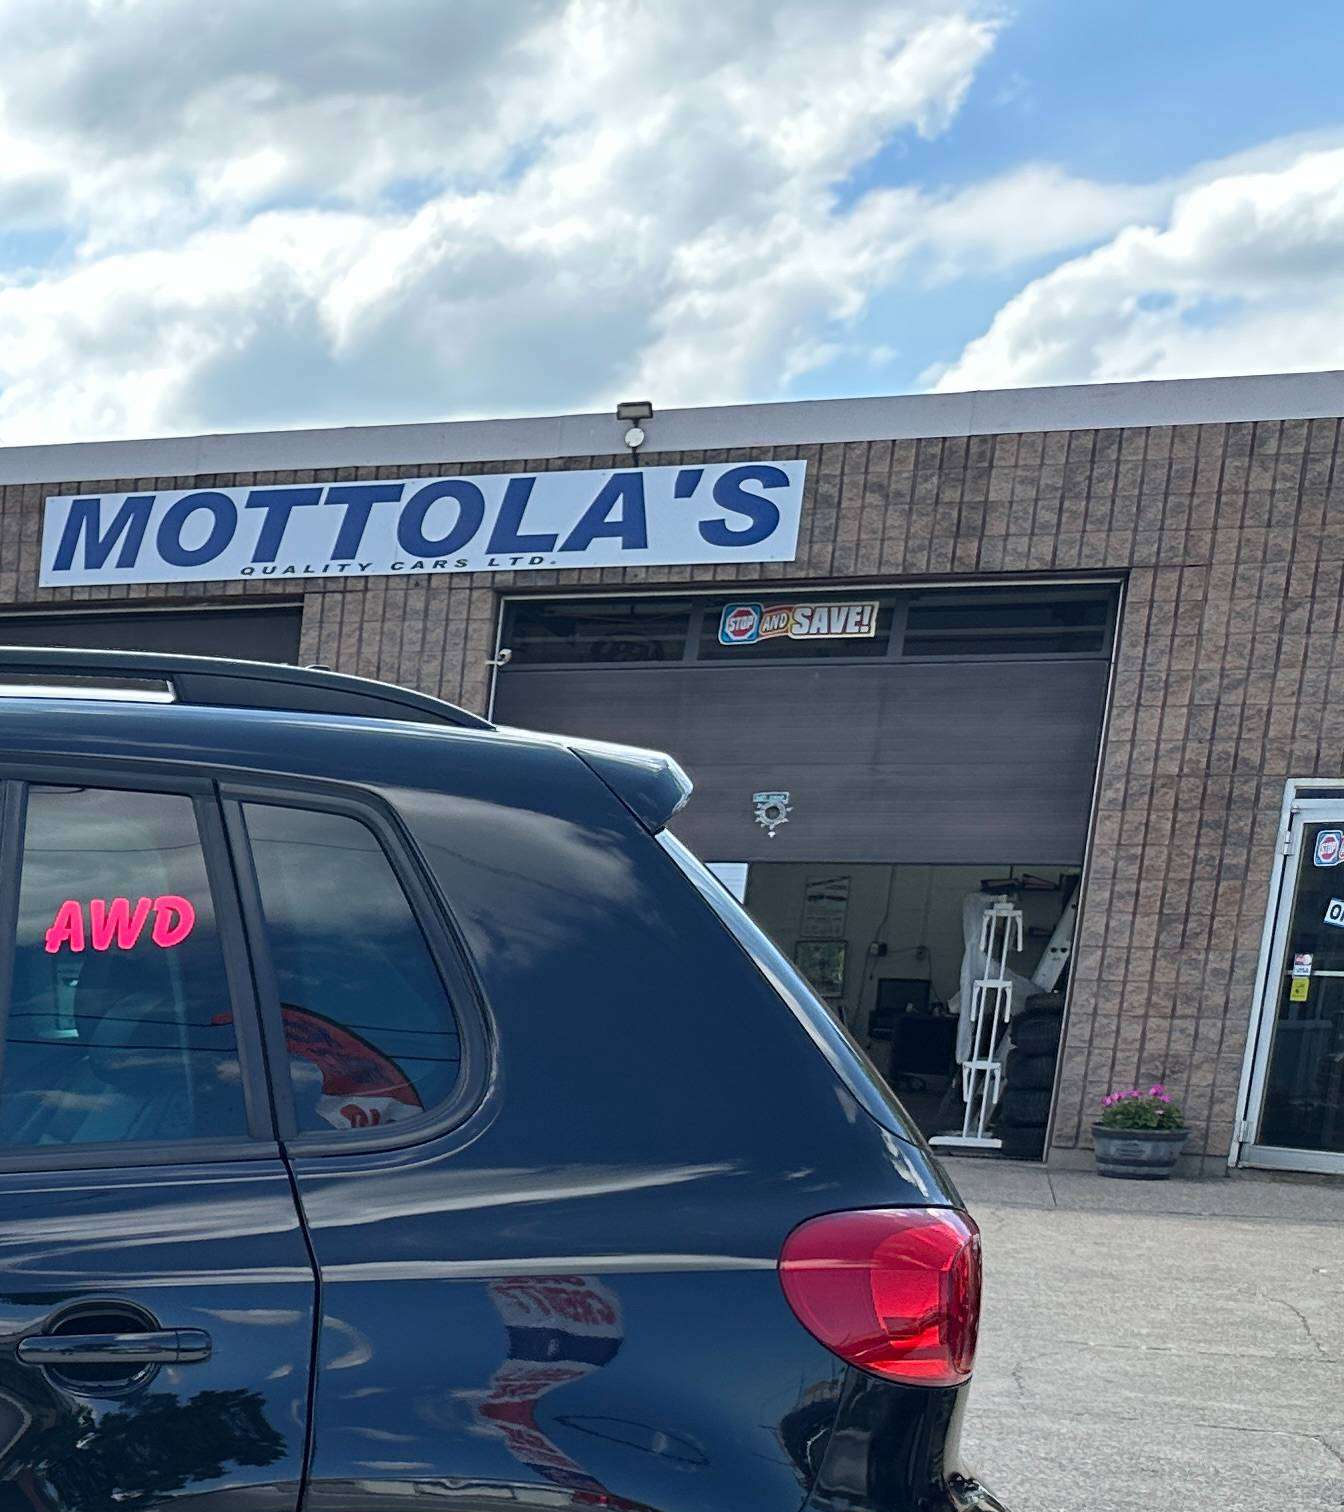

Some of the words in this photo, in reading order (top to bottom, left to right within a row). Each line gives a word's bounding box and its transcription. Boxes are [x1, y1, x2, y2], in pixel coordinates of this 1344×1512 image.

[51, 464, 791, 571] MOTTOLA'S
[240, 562, 374, 576] QUALITY
[390, 558, 470, 571] CARS
[487, 555, 558, 567] LTD.
[728, 615, 754, 632] STOP
[762, 613, 789, 632] AND
[791, 605, 874, 634] SAVE!
[44, 895, 196, 954] AWD
